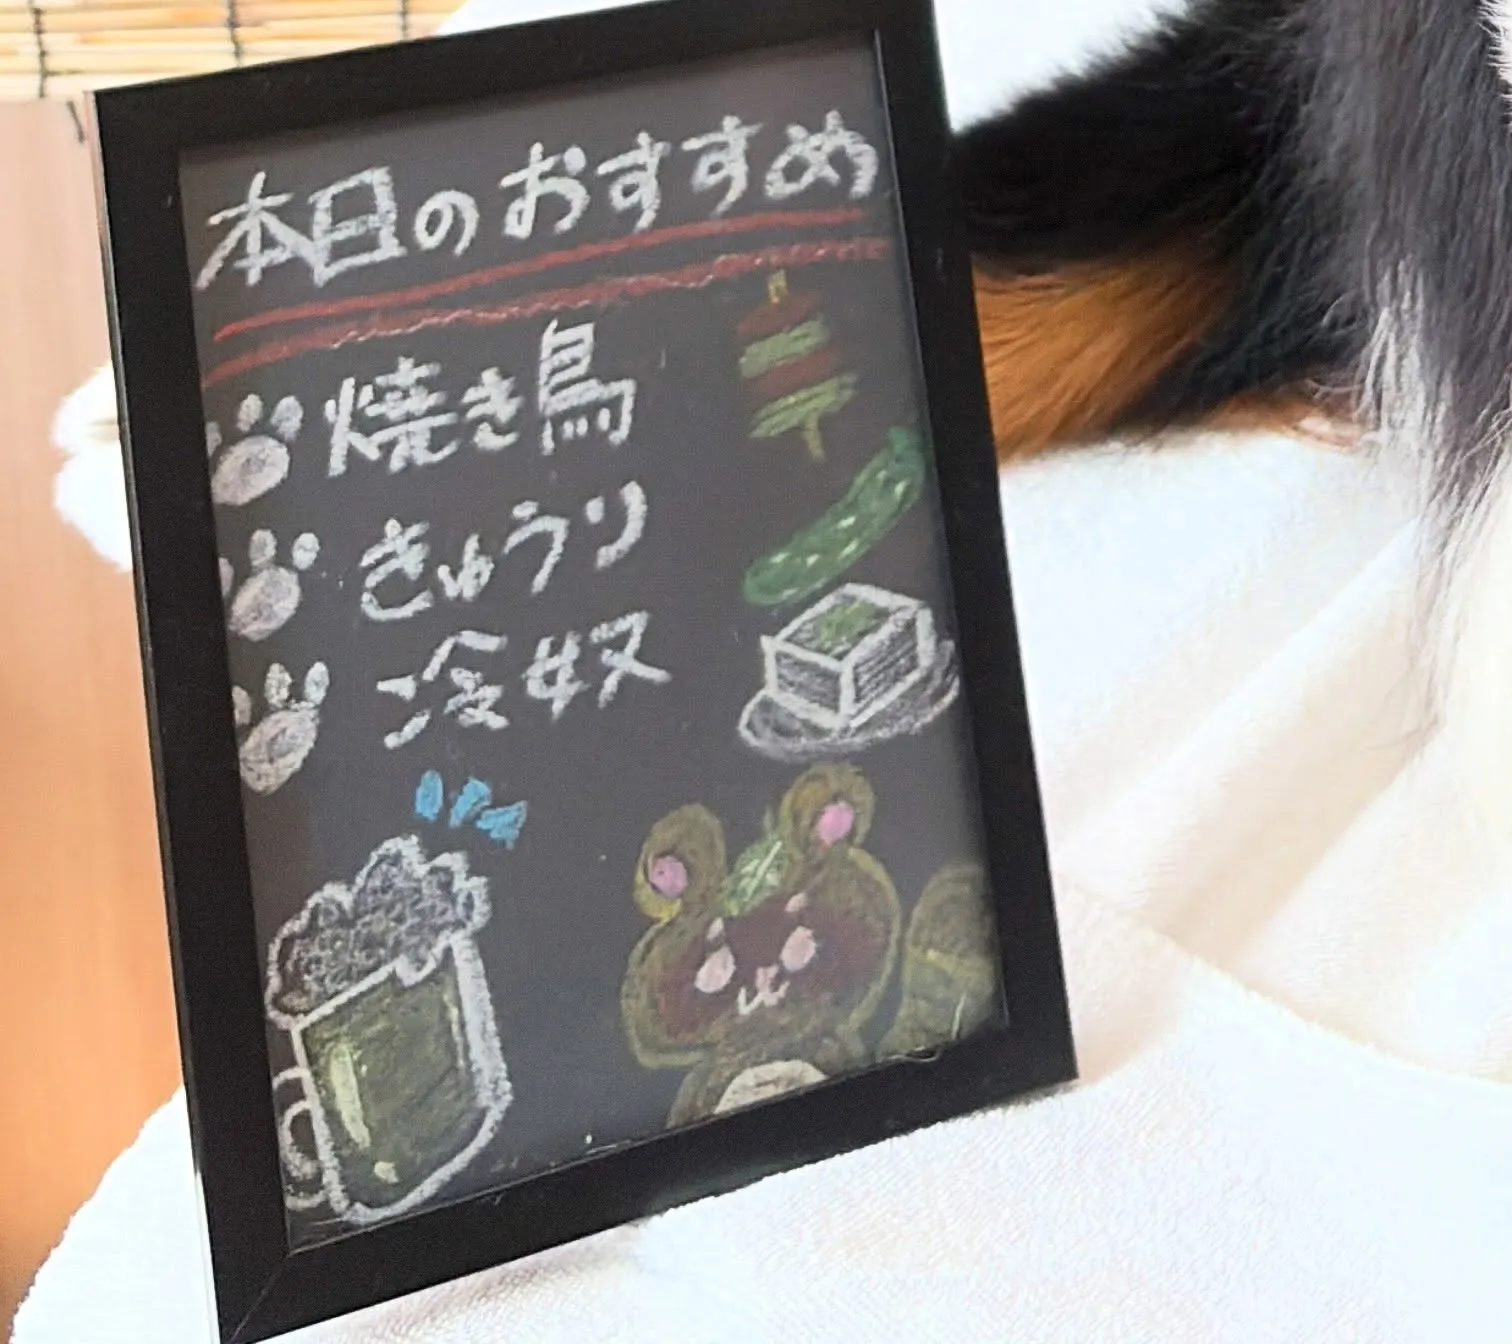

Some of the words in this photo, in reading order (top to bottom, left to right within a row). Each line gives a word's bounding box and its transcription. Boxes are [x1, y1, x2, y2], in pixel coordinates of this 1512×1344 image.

[197, 111, 882, 290] 本日のおすすめ
[324, 317, 637, 477] 焼き鳥
[360, 480, 648, 622] きゅうり
[376, 609, 671, 750] 冷奴
